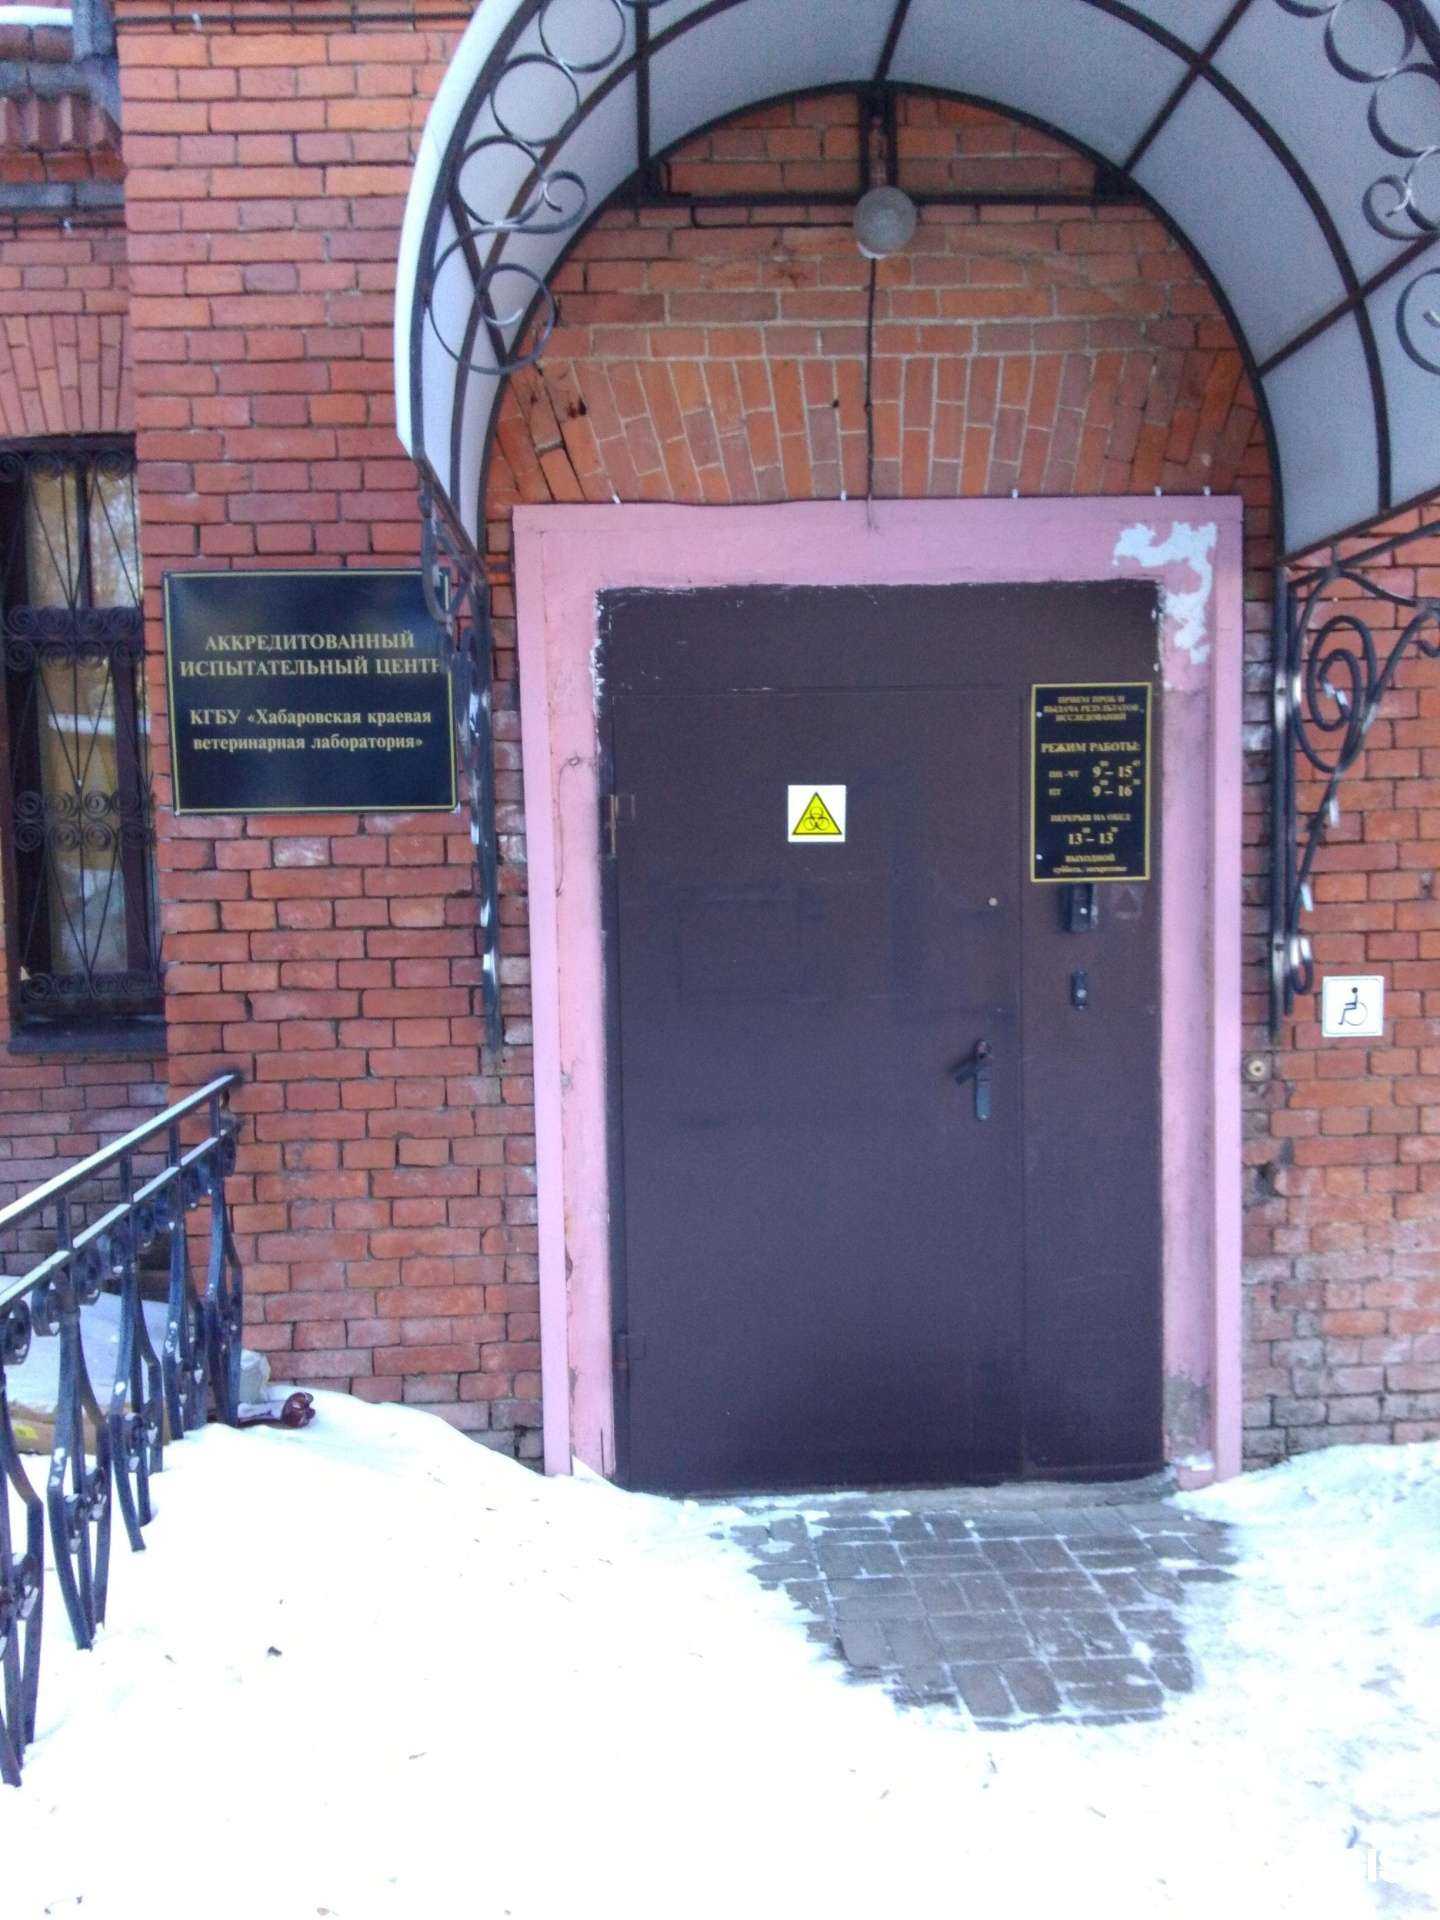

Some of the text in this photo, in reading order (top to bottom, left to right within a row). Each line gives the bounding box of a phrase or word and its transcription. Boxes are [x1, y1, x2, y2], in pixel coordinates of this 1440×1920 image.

[205, 630, 415, 651] АККРЕДИТОВАННЫЙ
[180, 656, 369, 677] ИСПЫТАТЕЛЬНЫЙ
[190, 708, 432, 728] КГБУ «Хабаровская краевая
[193, 734, 423, 752] ветеринарная лаборатория»
[1041, 743, 1086, 753] РЕЖИМ
